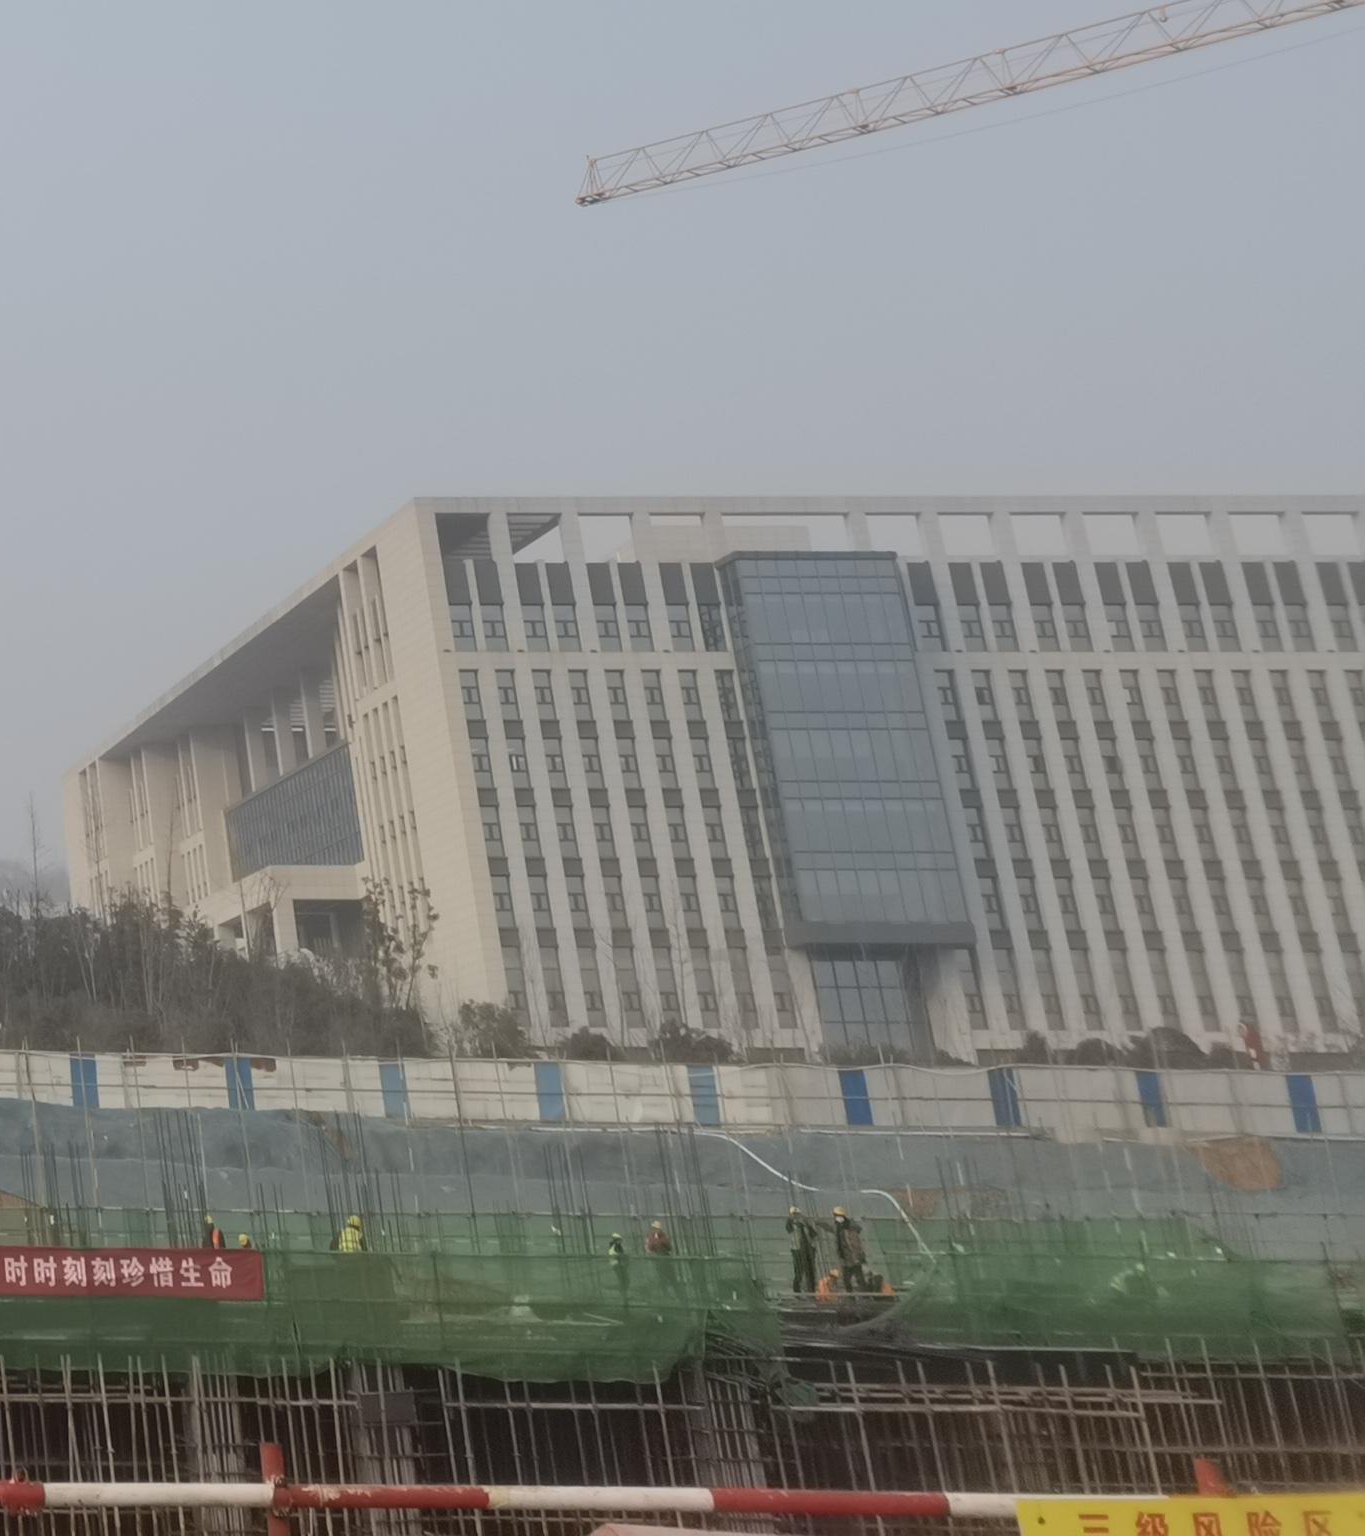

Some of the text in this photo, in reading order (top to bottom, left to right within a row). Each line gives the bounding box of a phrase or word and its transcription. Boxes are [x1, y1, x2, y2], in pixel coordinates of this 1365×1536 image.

[4, 1255, 234, 1289] 时时刻刻珍惜生命
